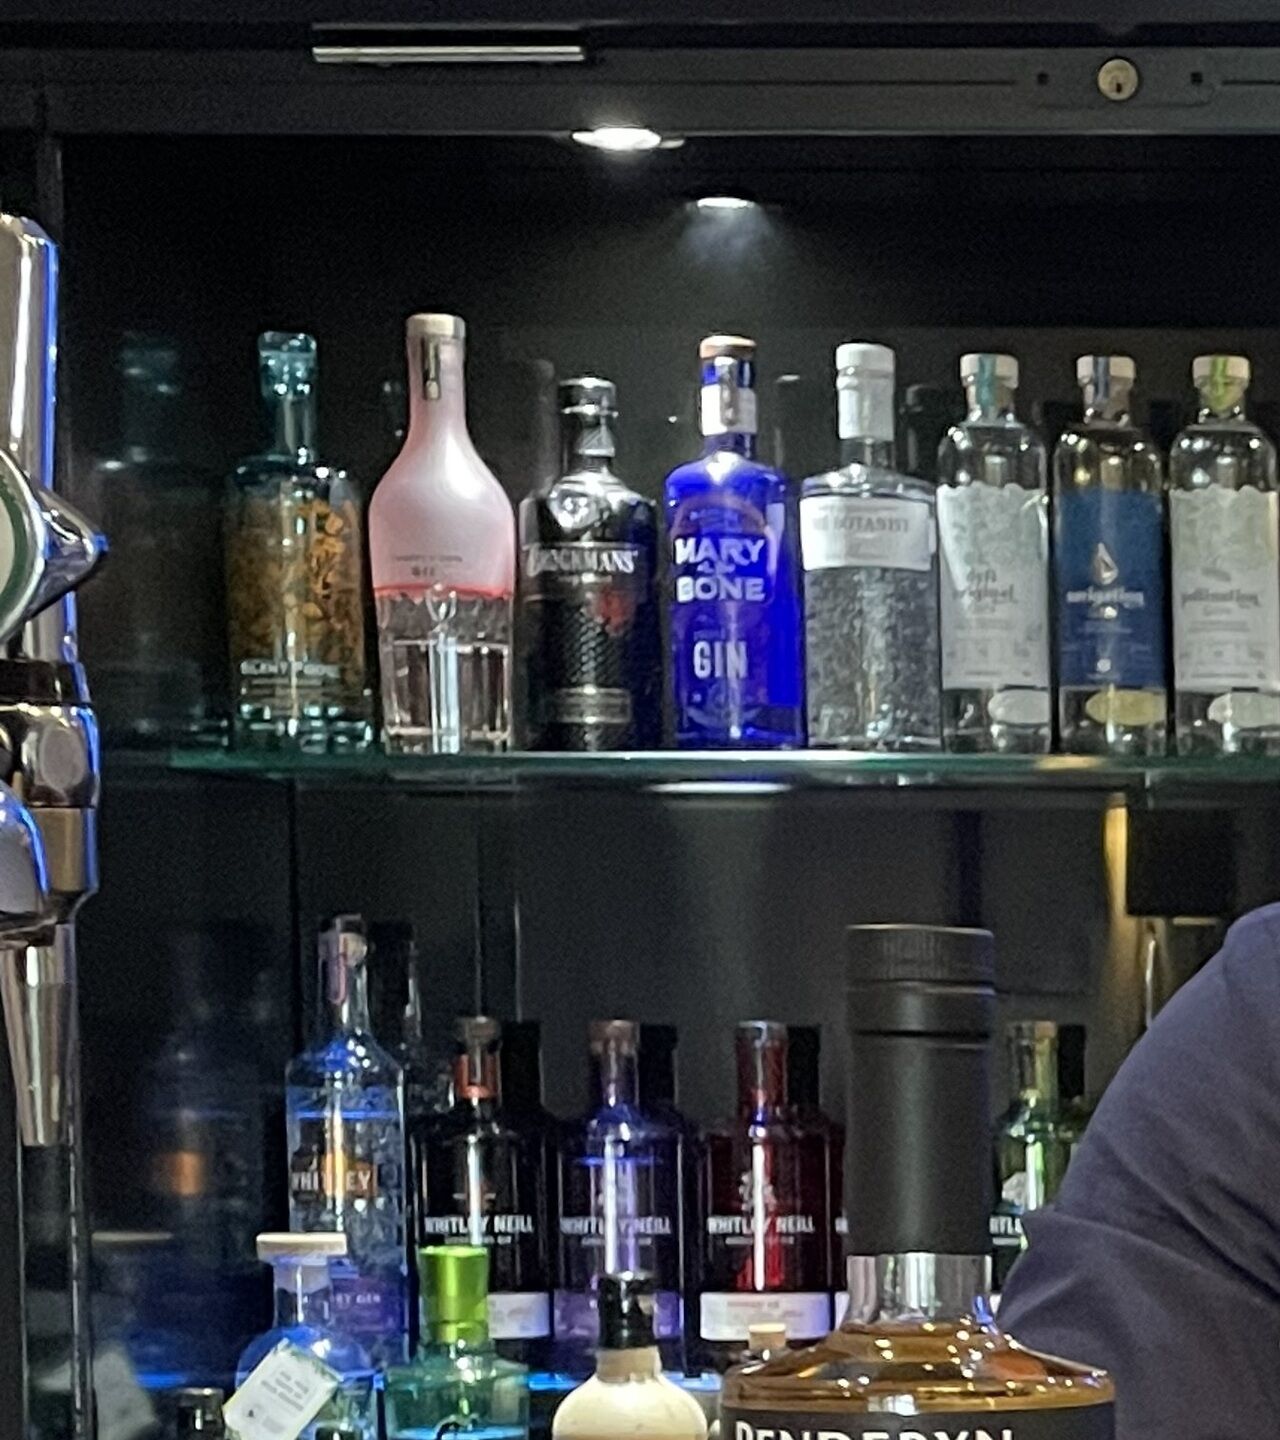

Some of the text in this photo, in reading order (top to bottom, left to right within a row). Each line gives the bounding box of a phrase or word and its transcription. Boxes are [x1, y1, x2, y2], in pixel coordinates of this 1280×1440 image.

[674, 537, 765, 566] MARY
[676, 575, 766, 603] BONE
[693, 640, 748, 679] GIN
